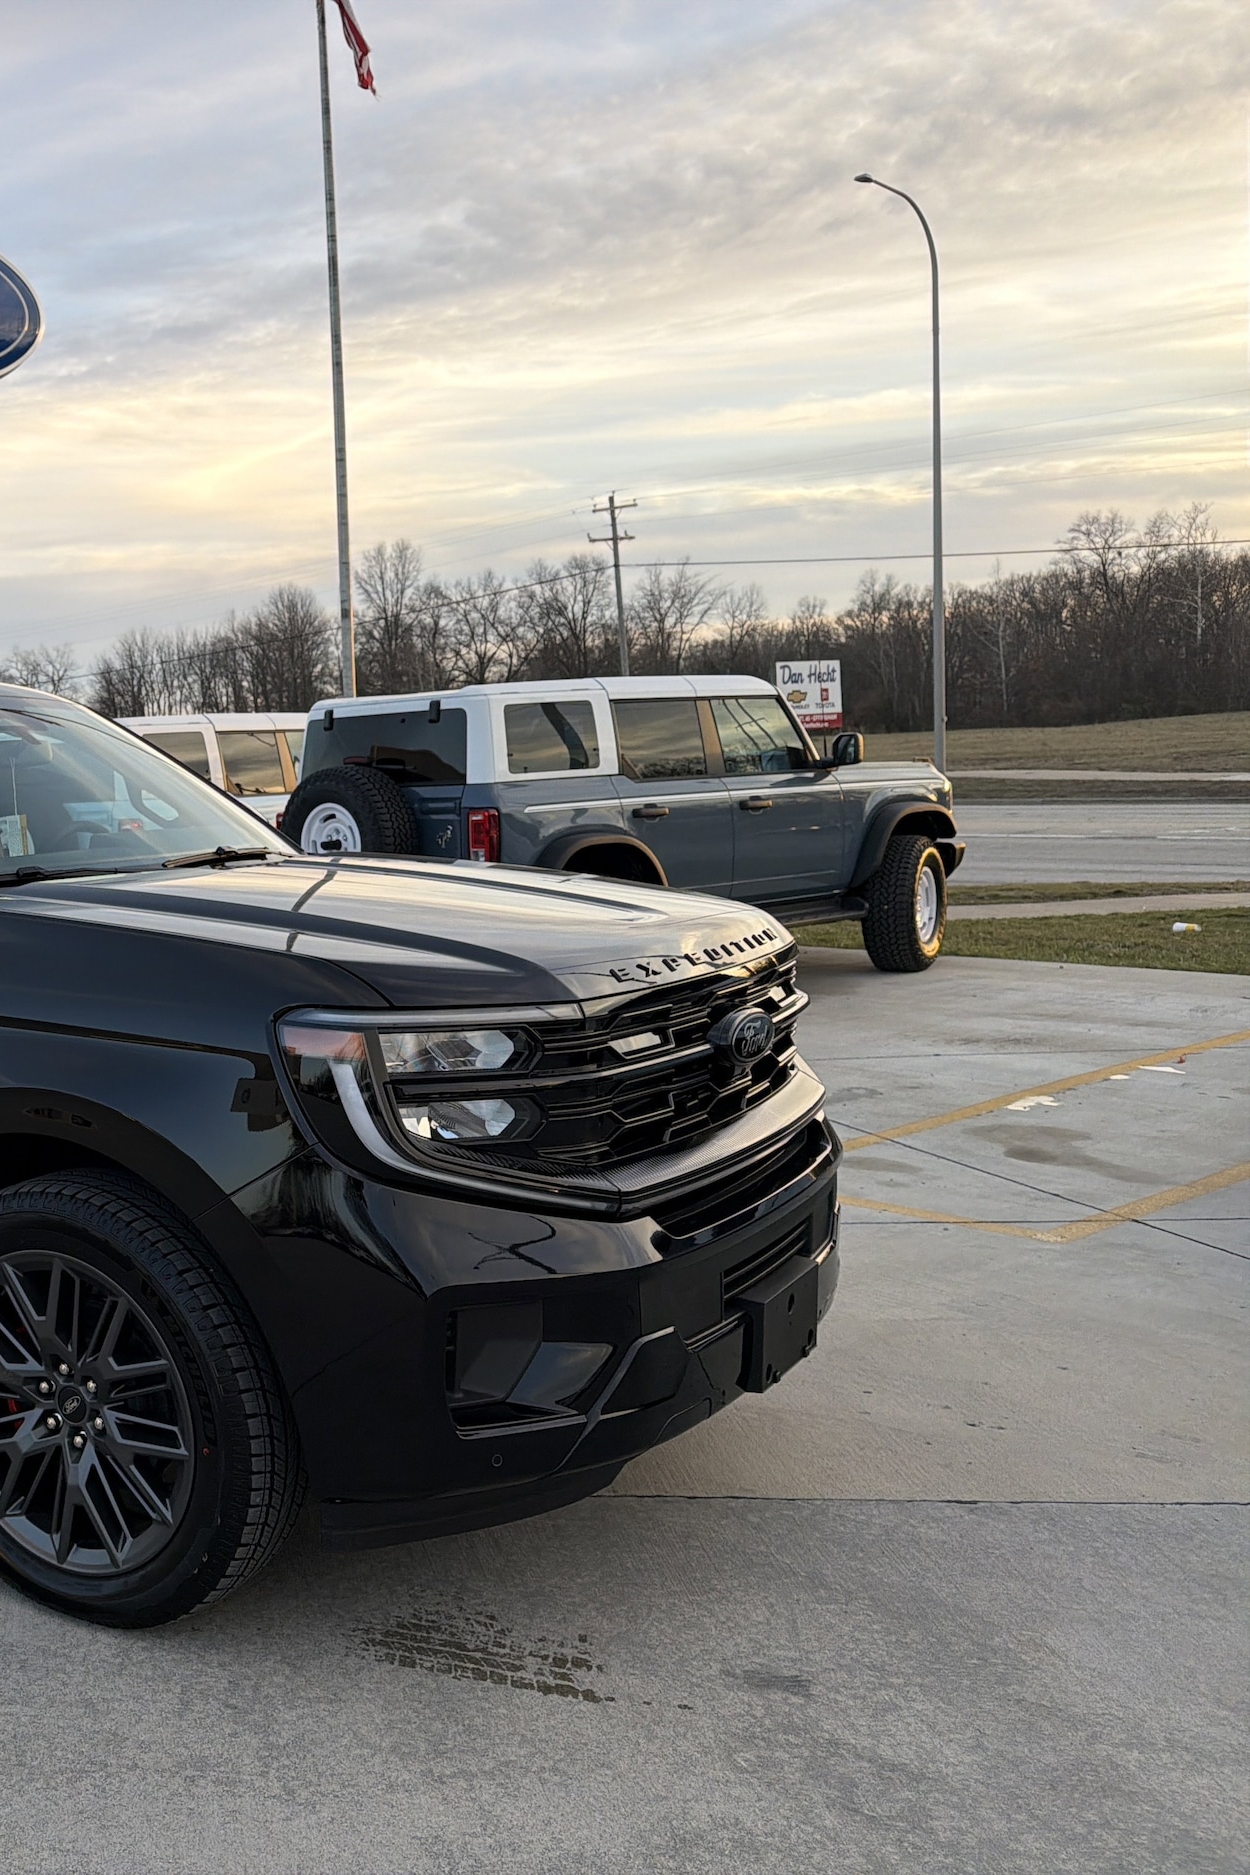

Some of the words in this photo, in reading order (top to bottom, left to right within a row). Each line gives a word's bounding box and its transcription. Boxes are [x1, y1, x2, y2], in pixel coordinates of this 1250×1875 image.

[780, 664, 805, 684] Dan
[807, 664, 837, 684] Hecht
[609, 927, 779, 983] EXPEDITION
[741, 1019, 769, 1055] Ford
